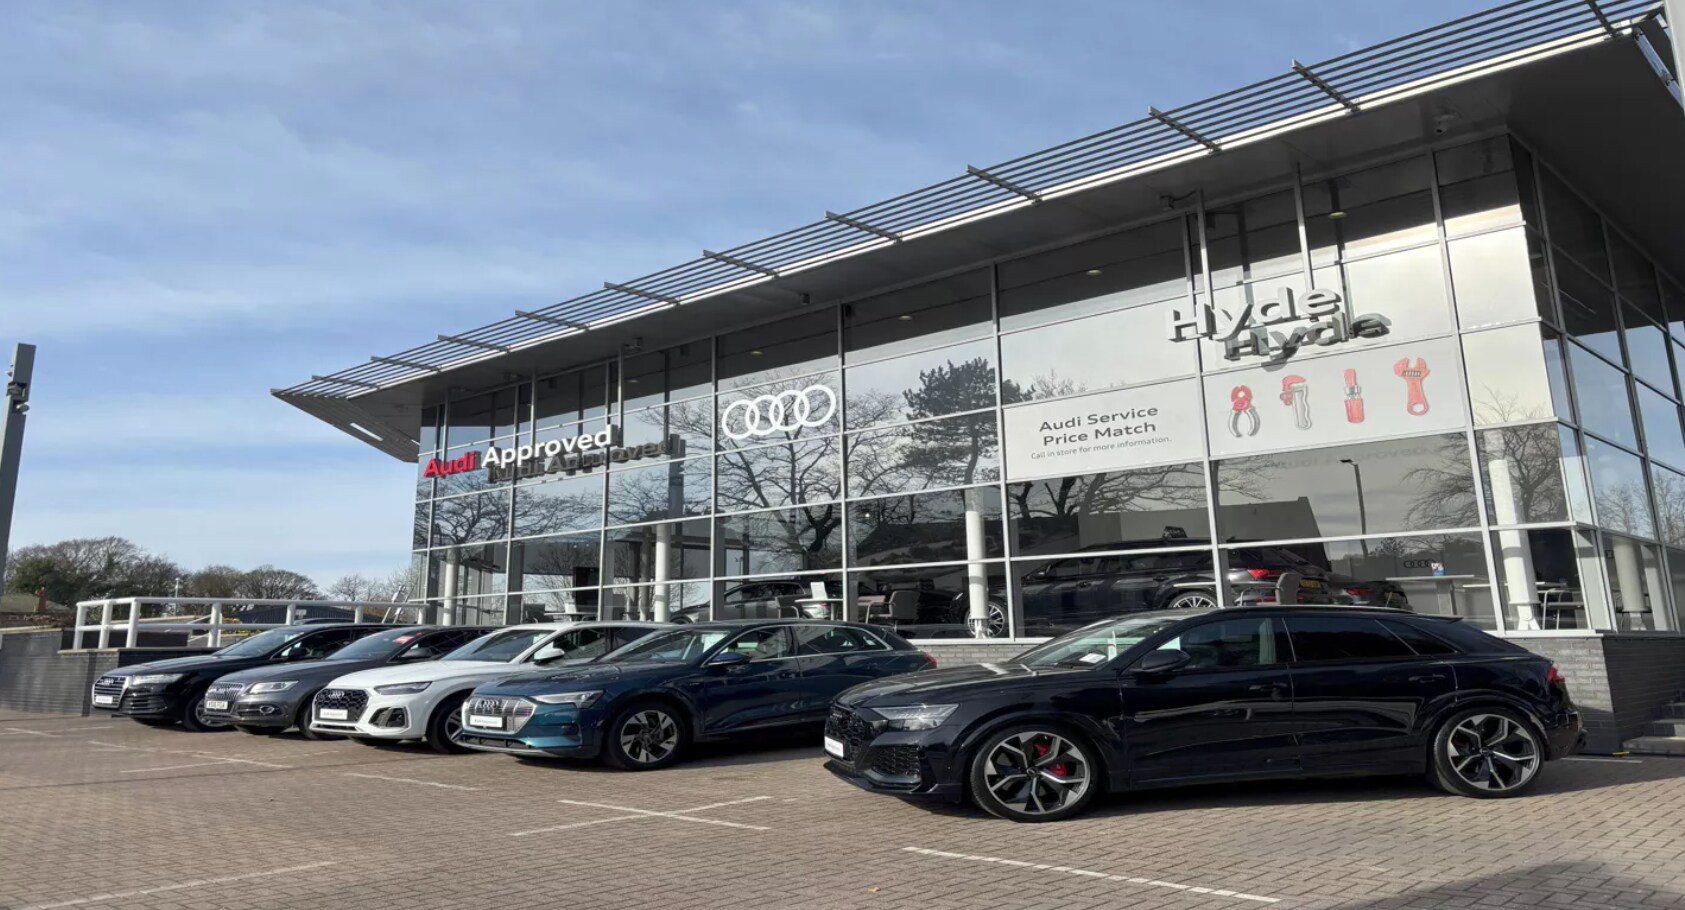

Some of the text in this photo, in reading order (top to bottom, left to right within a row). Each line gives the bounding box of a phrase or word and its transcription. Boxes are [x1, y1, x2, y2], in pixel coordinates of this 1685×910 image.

[1166, 287, 1341, 342] Hyde
[1039, 407, 1159, 432] Audi Service
[1043, 422, 1156, 446] Price Match
[423, 424, 612, 478] Audi Approved
[1031, 451, 1046, 459] Call
[1056, 448, 1078, 456] store
[1093, 443, 1115, 452] more
[1117, 436, 1173, 448] information.
